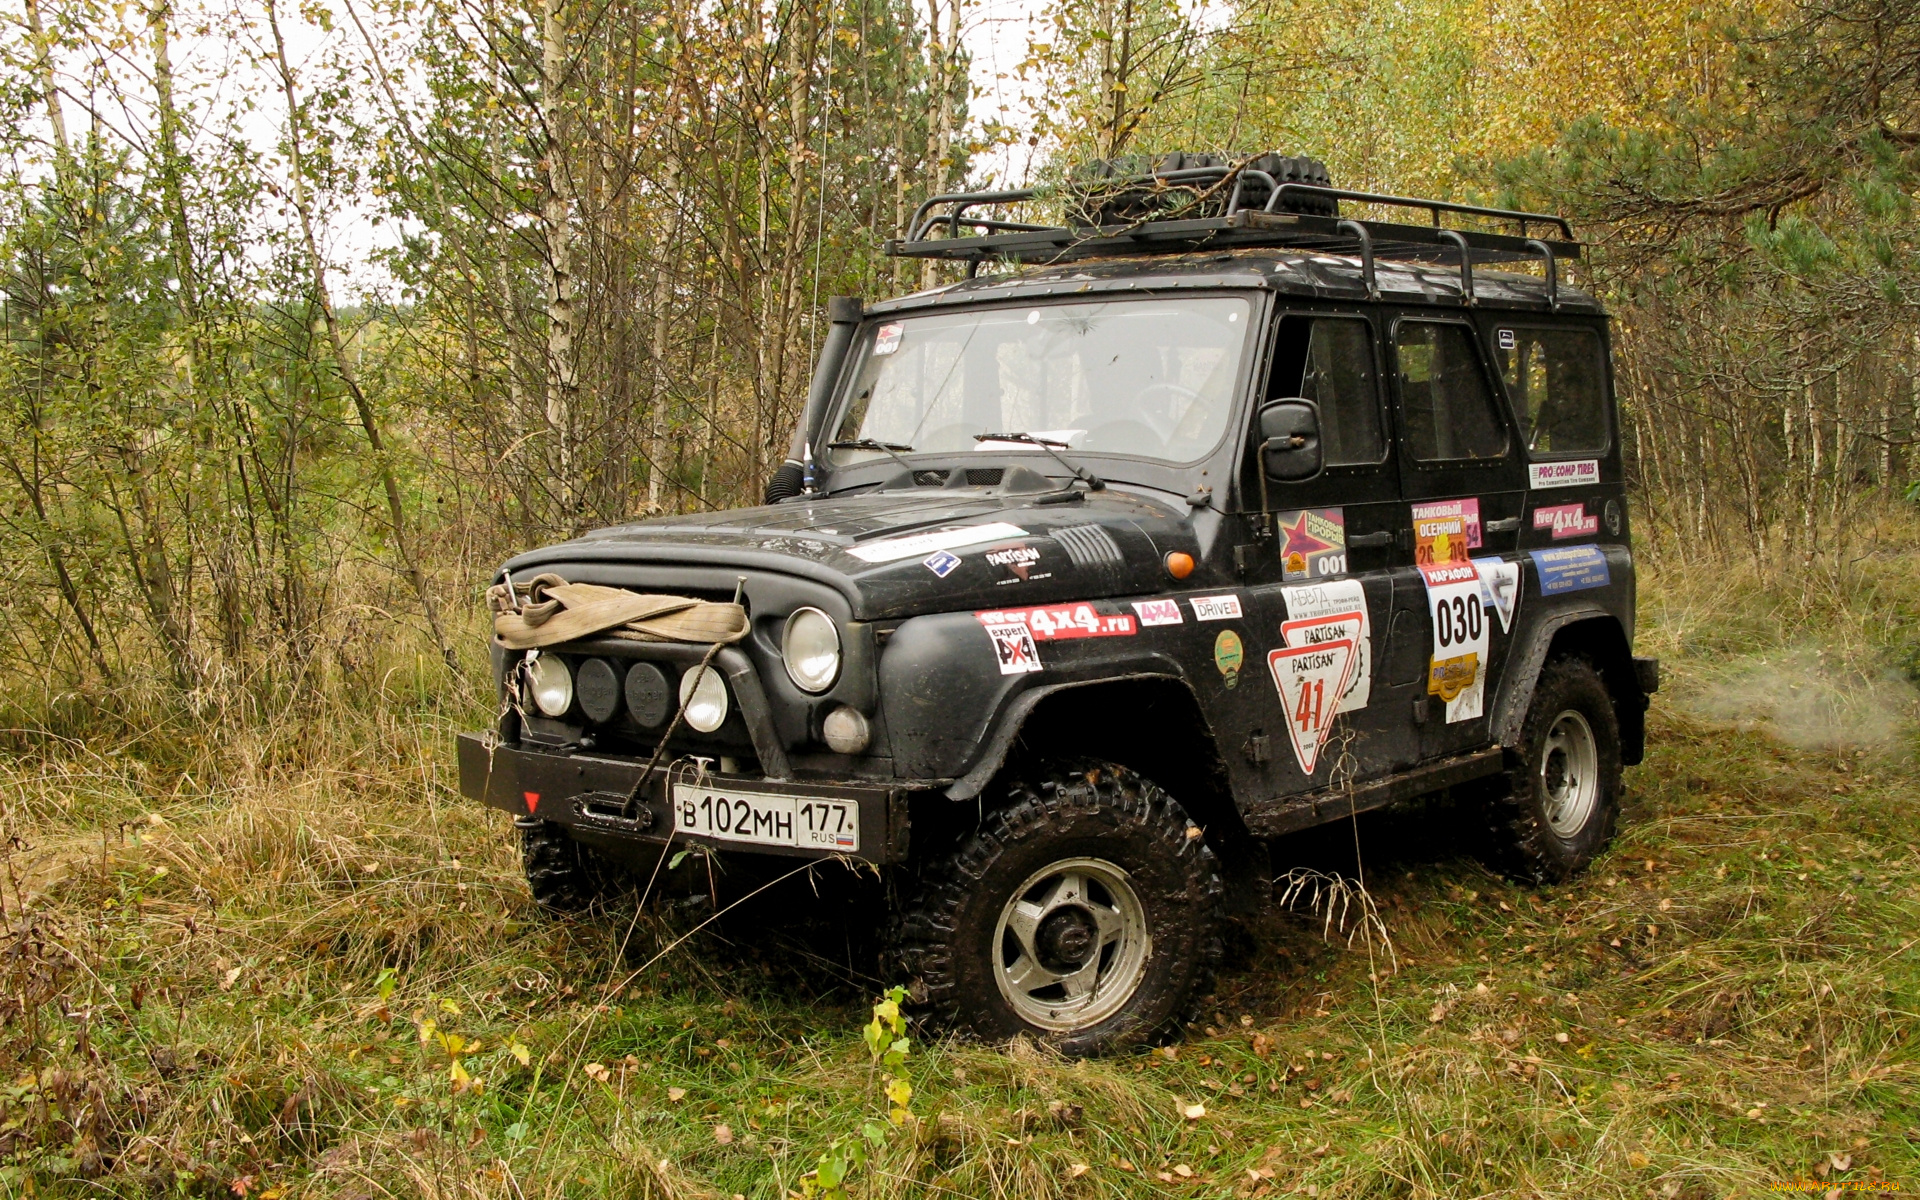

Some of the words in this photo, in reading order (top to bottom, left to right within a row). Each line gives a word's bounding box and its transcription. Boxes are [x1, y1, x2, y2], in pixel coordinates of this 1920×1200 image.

[876, 341, 899, 354] 001
[1538, 465, 1554, 478] PRO
[1556, 464, 1576, 477] COMP
[1577, 462, 1595, 475] TIRES
[1411, 501, 1462, 520] ТАНКОВЫЙ
[1308, 522, 1344, 545] ПРОРЫВ
[1419, 518, 1462, 538] ОСЕННИЙ
[1318, 554, 1347, 575] 001
[1427, 566, 1474, 584] МАРАФОН
[1437, 593, 1482, 648] 030
[992, 625, 1028, 638] expert
[1295, 678, 1324, 733] 41
[800, 802, 846, 833] 177
[811, 831, 835, 844] RUS
